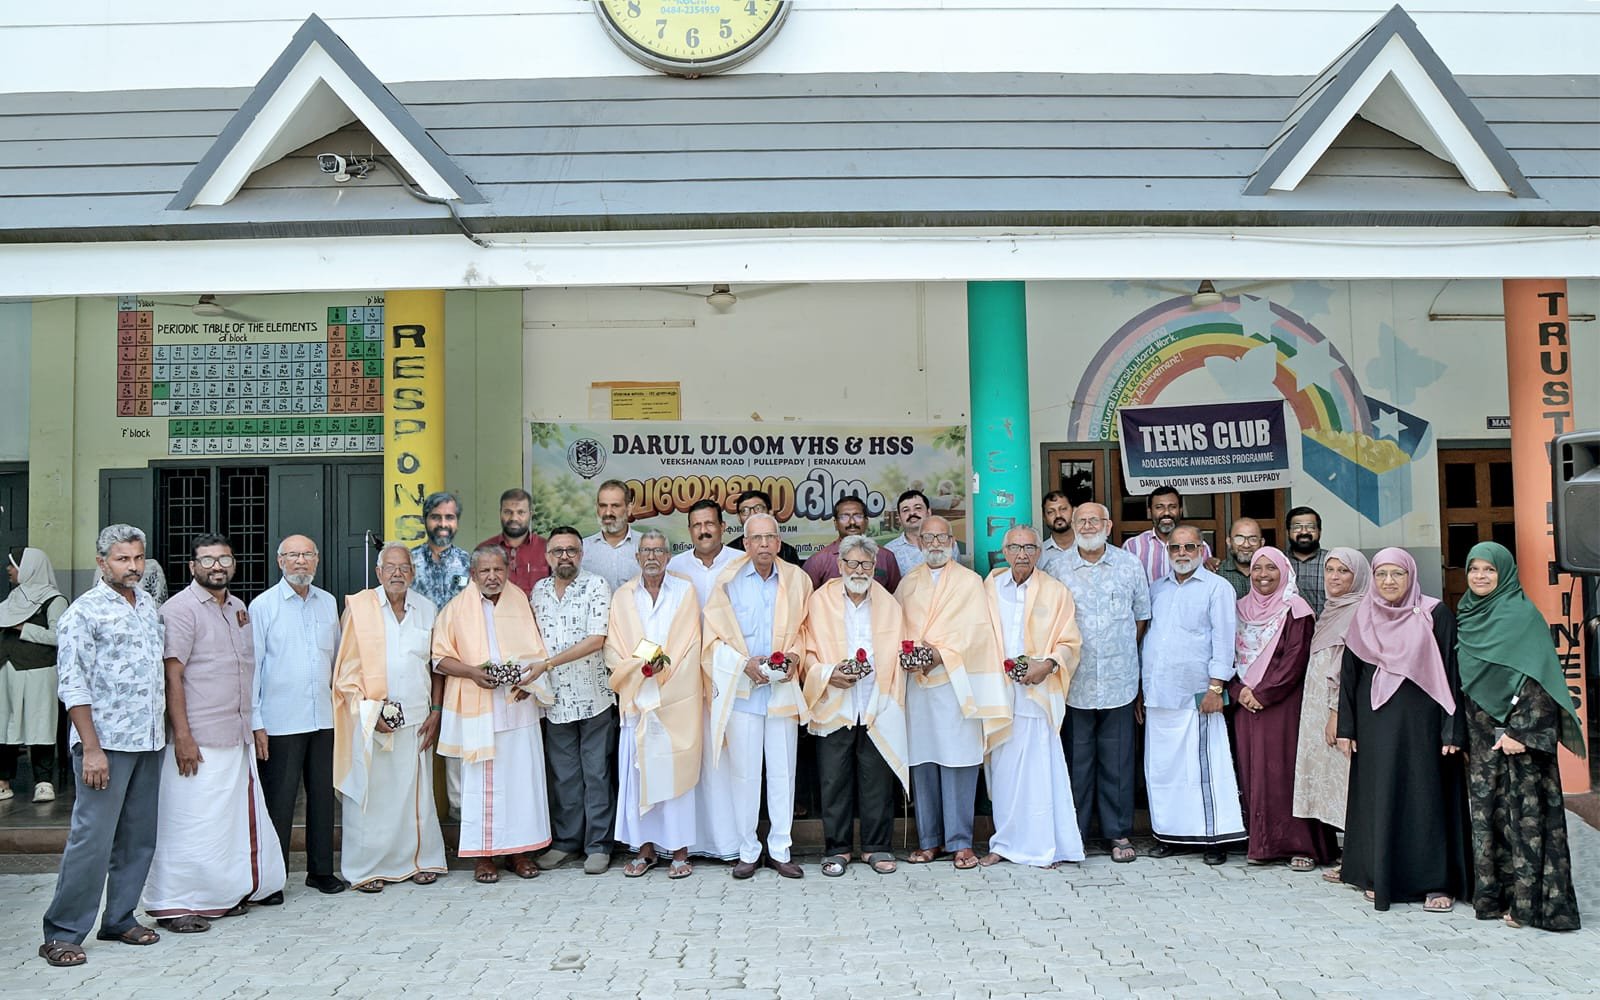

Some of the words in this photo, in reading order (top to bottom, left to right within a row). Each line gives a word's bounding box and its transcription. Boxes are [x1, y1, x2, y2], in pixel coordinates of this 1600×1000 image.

[627, 0, 642, 18] 8
[744, 0, 758, 16] 4
[656, 19, 668, 39] 7
[719, 19, 732, 39] 5
[685, 28, 700, 48] 6
[157, 323, 199, 334] PERIODIC
[203, 323, 230, 333] TABLE
[232, 322, 244, 333] OF
[245, 322, 264, 332] THE
[266, 322, 318, 332] ELEMENTS
[229, 334, 247, 342] block
[129, 428, 151, 438] block
[1139, 422, 1208, 452] TEENS
[1212, 419, 1271, 449] CLUB
[612, 435, 694, 455] DARUL
[701, 436, 784, 455] ULOOM
[791, 436, 838, 455] VHS
[845, 436, 862, 455] &
[869, 436, 914, 455] HSS
[1142, 457, 1189, 469] ADOLESCENCE
[1190, 454, 1231, 467] AWARENESS
[1232, 452, 1274, 464] PROGRAMME
[1190, 476, 1209, 486] VHSS
[1210, 477, 1216, 485] &
[1237, 472, 1280, 483] PULLEPPADY
